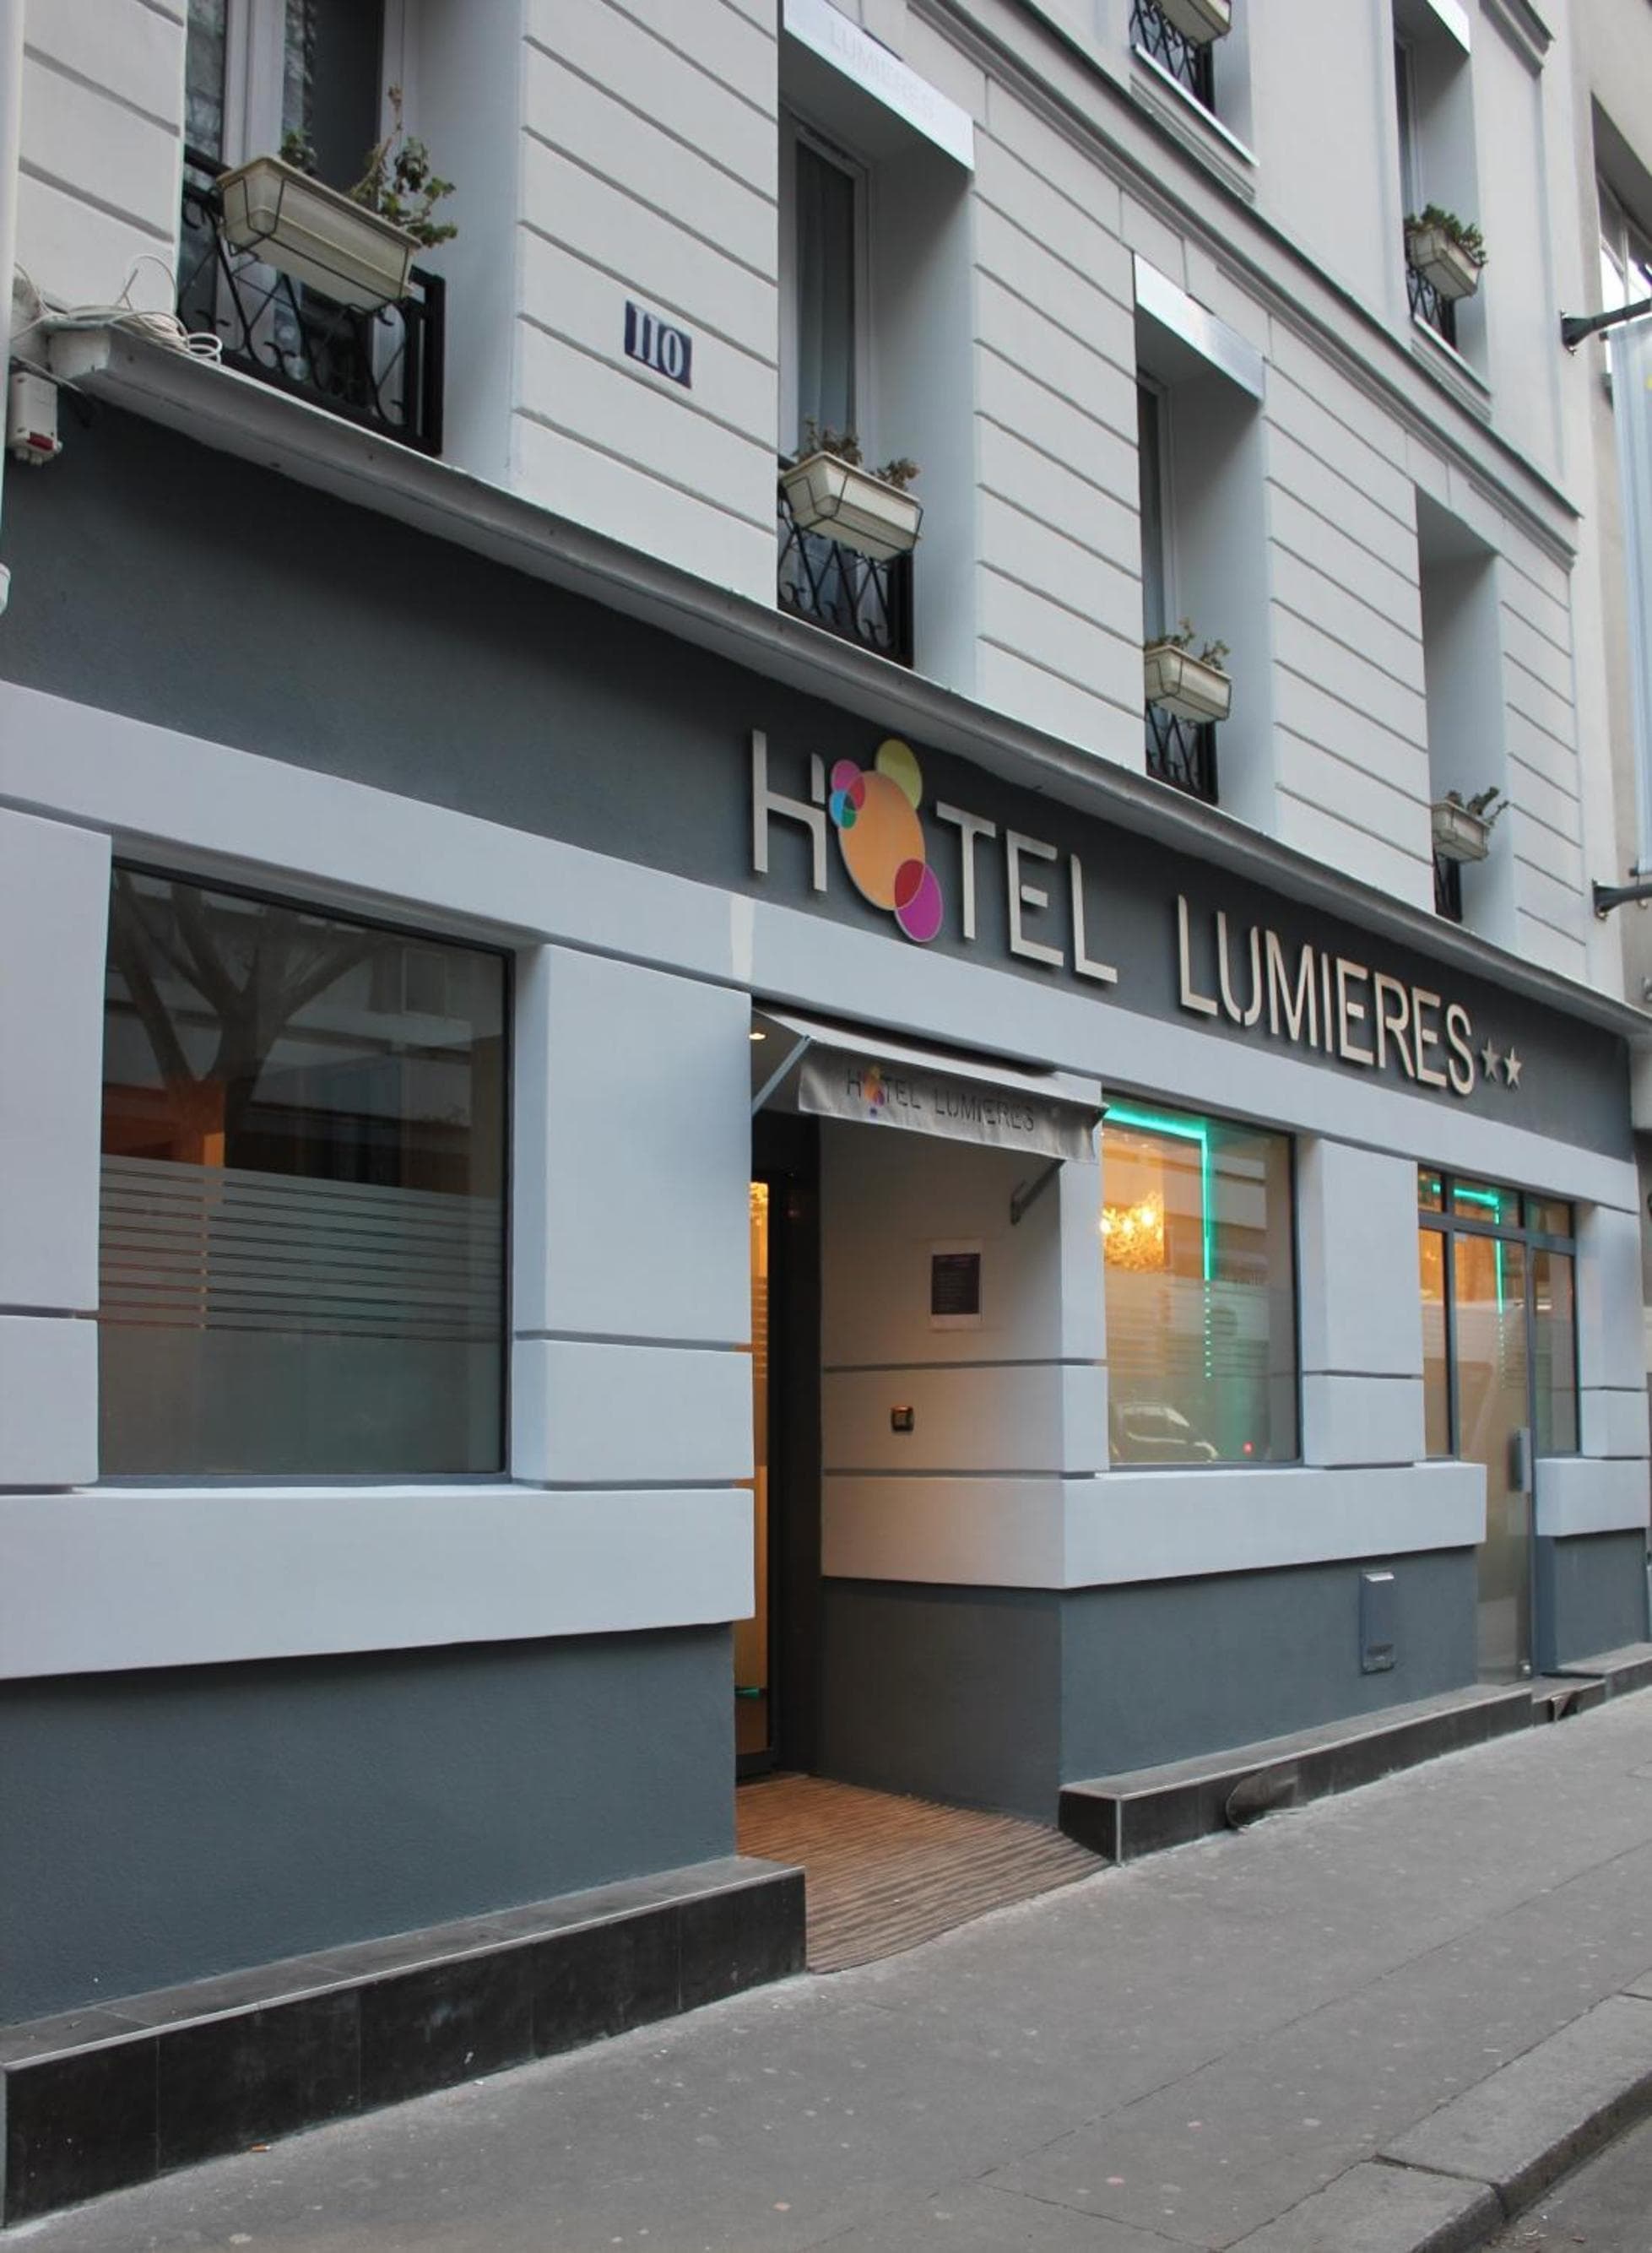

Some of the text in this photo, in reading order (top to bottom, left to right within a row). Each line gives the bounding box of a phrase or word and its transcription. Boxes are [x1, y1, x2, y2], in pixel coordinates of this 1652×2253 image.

[633, 306, 684, 378] 110
[1178, 895, 1474, 1096] LUMIERES
[935, 1088, 1035, 1132] LUMIERES
